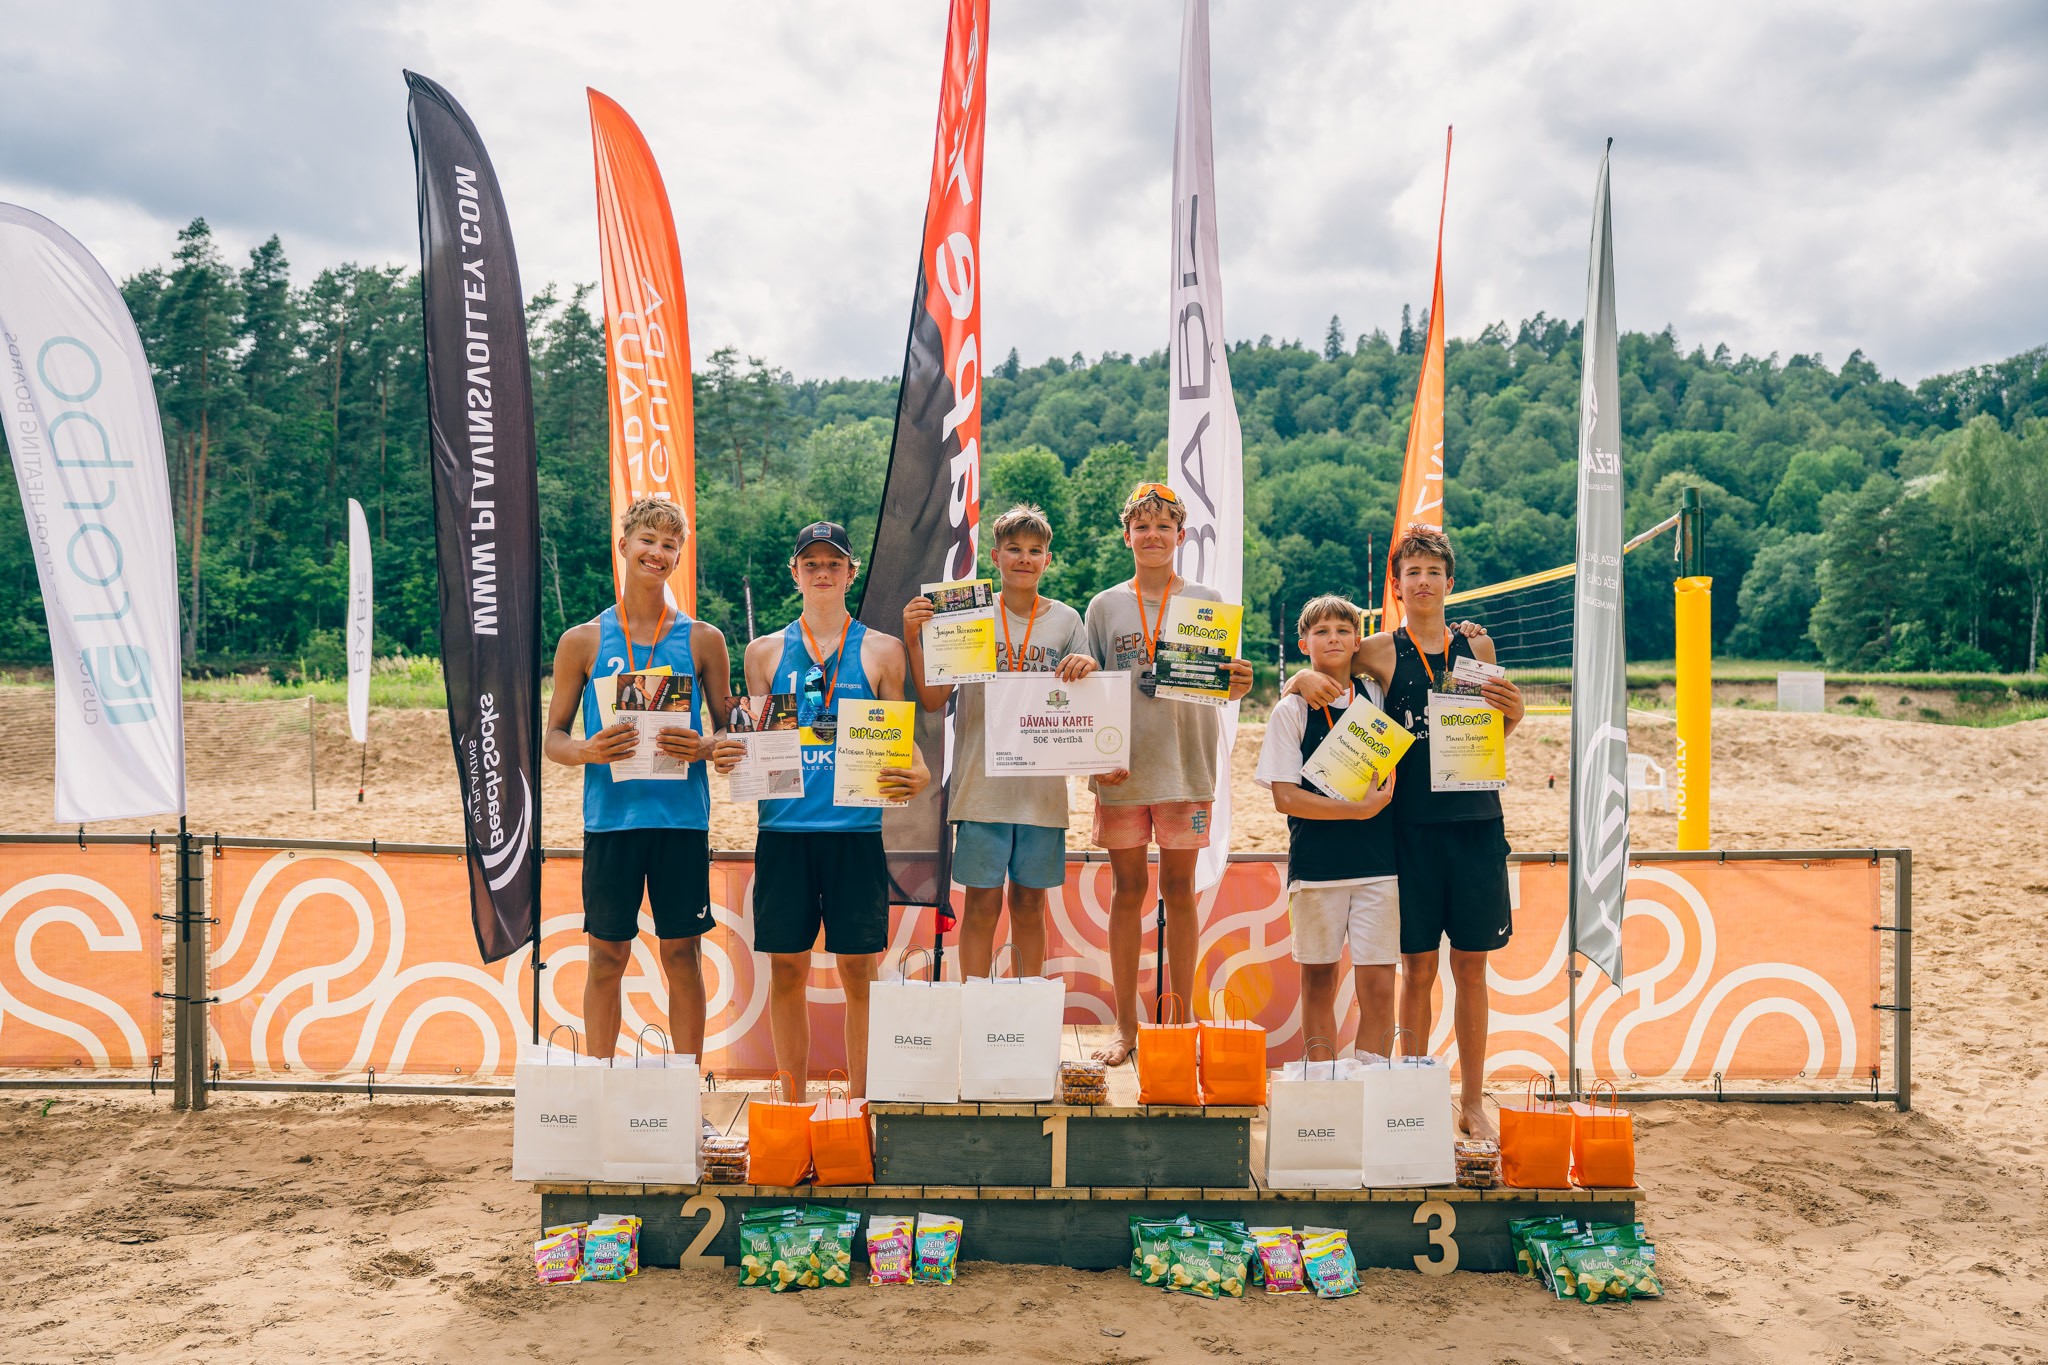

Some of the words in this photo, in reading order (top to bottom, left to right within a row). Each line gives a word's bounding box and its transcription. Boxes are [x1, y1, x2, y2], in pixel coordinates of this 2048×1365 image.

[1177, 623, 1228, 641] DIPLOMS
[607, 656, 625, 677] 2
[787, 671, 798, 694] 1
[1020, 715, 1059, 728] DĀVANU
[1062, 715, 1094, 727] KARTE
[1441, 713, 1492, 727] DIPLOMS
[849, 727, 902, 740] DIPLOMS
[1033, 736, 1048, 744] 50€
[1053, 735, 1083, 744] vērtībā
[1348, 721, 1391, 758] DIPLOMS
[894, 1035, 932, 1046] BABE
[987, 1033, 1025, 1043] BABE
[540, 1114, 578, 1124] BABE
[630, 1118, 668, 1128] BABE
[1387, 1118, 1425, 1128] BABE
[1298, 1128, 1336, 1138] BABE
[1042, 1116, 1067, 1188] 1
[680, 1195, 726, 1269] 2
[1412, 1201, 1461, 1275] 3
[751, 1240, 771, 1253] Natu
[781, 1243, 813, 1259] Naturals
[880, 1262, 898, 1271] mix
[1179, 1251, 1211, 1269] Naturals
[1581, 1258, 1615, 1272] Naturals
[1620, 1258, 1647, 1268] aturals
[924, 1265, 941, 1273] max
[1275, 1270, 1293, 1279] mix
